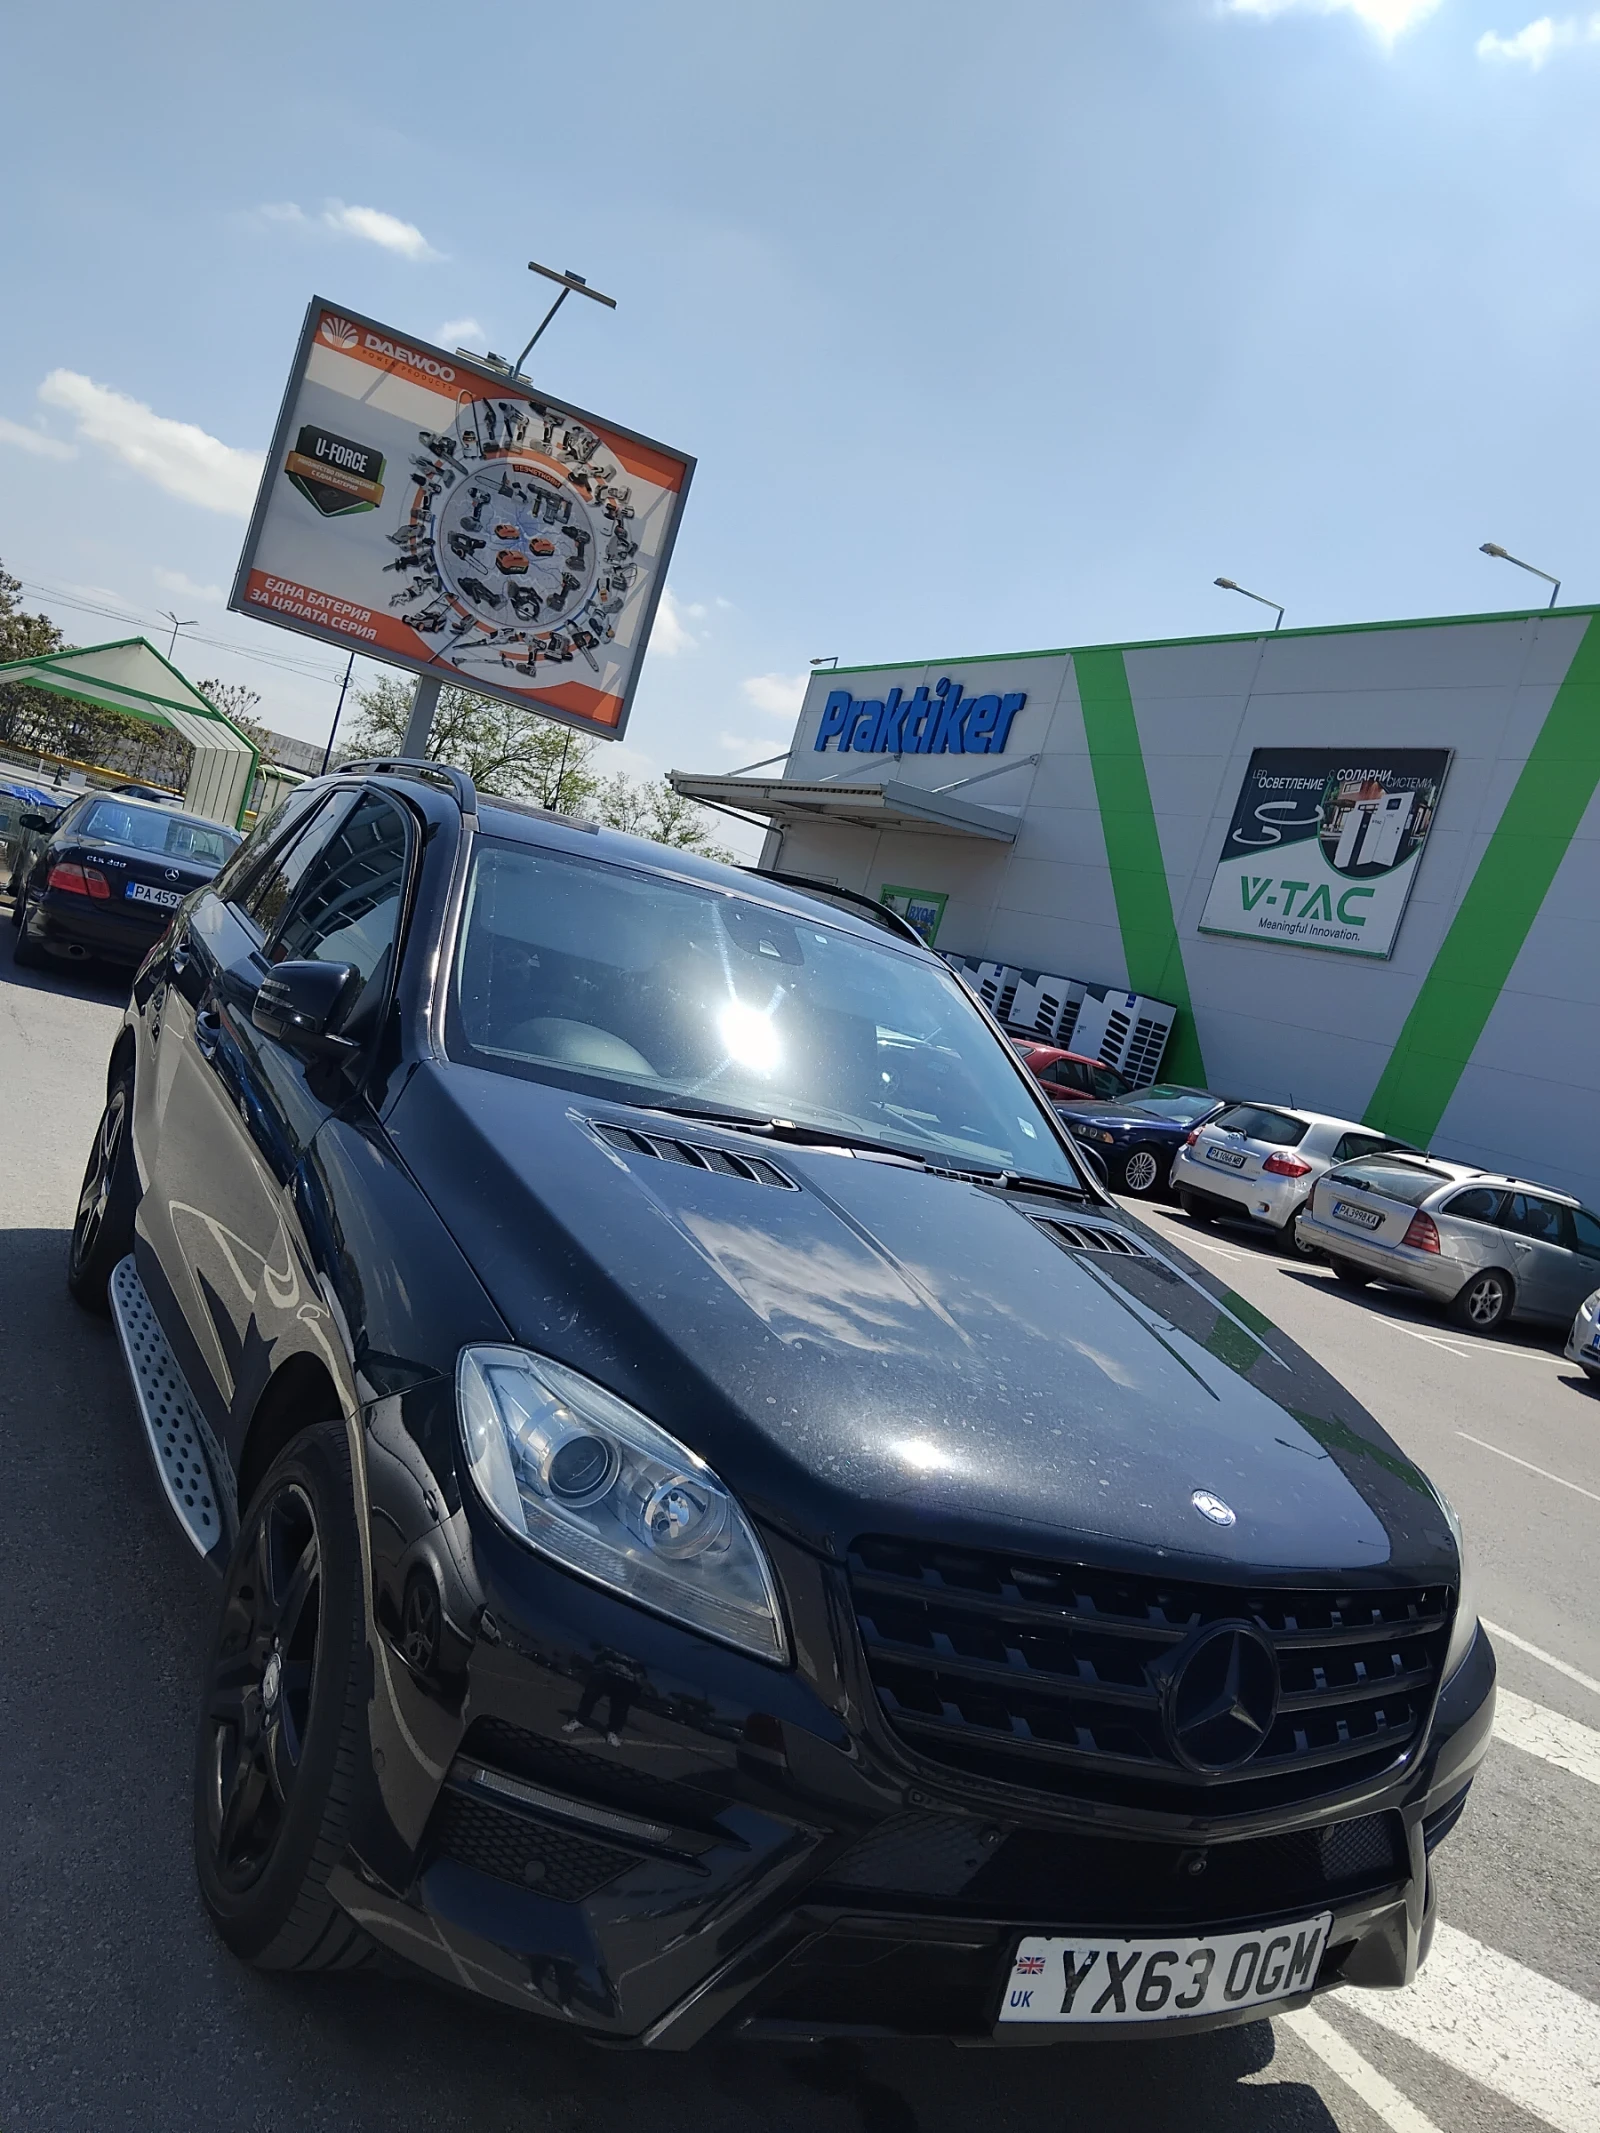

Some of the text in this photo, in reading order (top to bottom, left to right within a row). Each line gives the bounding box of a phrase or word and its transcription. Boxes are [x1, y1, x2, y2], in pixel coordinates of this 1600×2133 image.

[362, 349, 453, 391] POWER PRODUCTS
[364, 333, 455, 382] DAEWOO
[315, 438, 368, 473] U-FORCE
[250, 588, 377, 641] ЗА ЦЯЛАТА СЕРИЯ
[264, 577, 372, 623] ЕДНА БАТЕРИЯ
[814, 677, 1027, 754] Praktiker
[1253, 769, 1268, 779] LED
[1258, 777, 1325, 791] ОСВЕТЛЕНИЕ
[1336, 769, 1432, 788] СОЛАРНИ СИСТЕМИ
[135, 885, 151, 900] PA
[1241, 875, 1375, 927] V-TAC
[908, 906, 936, 926] ВХОД
[1258, 917, 1361, 942] Meaningful Innovation.
[1059, 1927, 1323, 2014] YX63 OGM
[1010, 1990, 1034, 2008] UK
